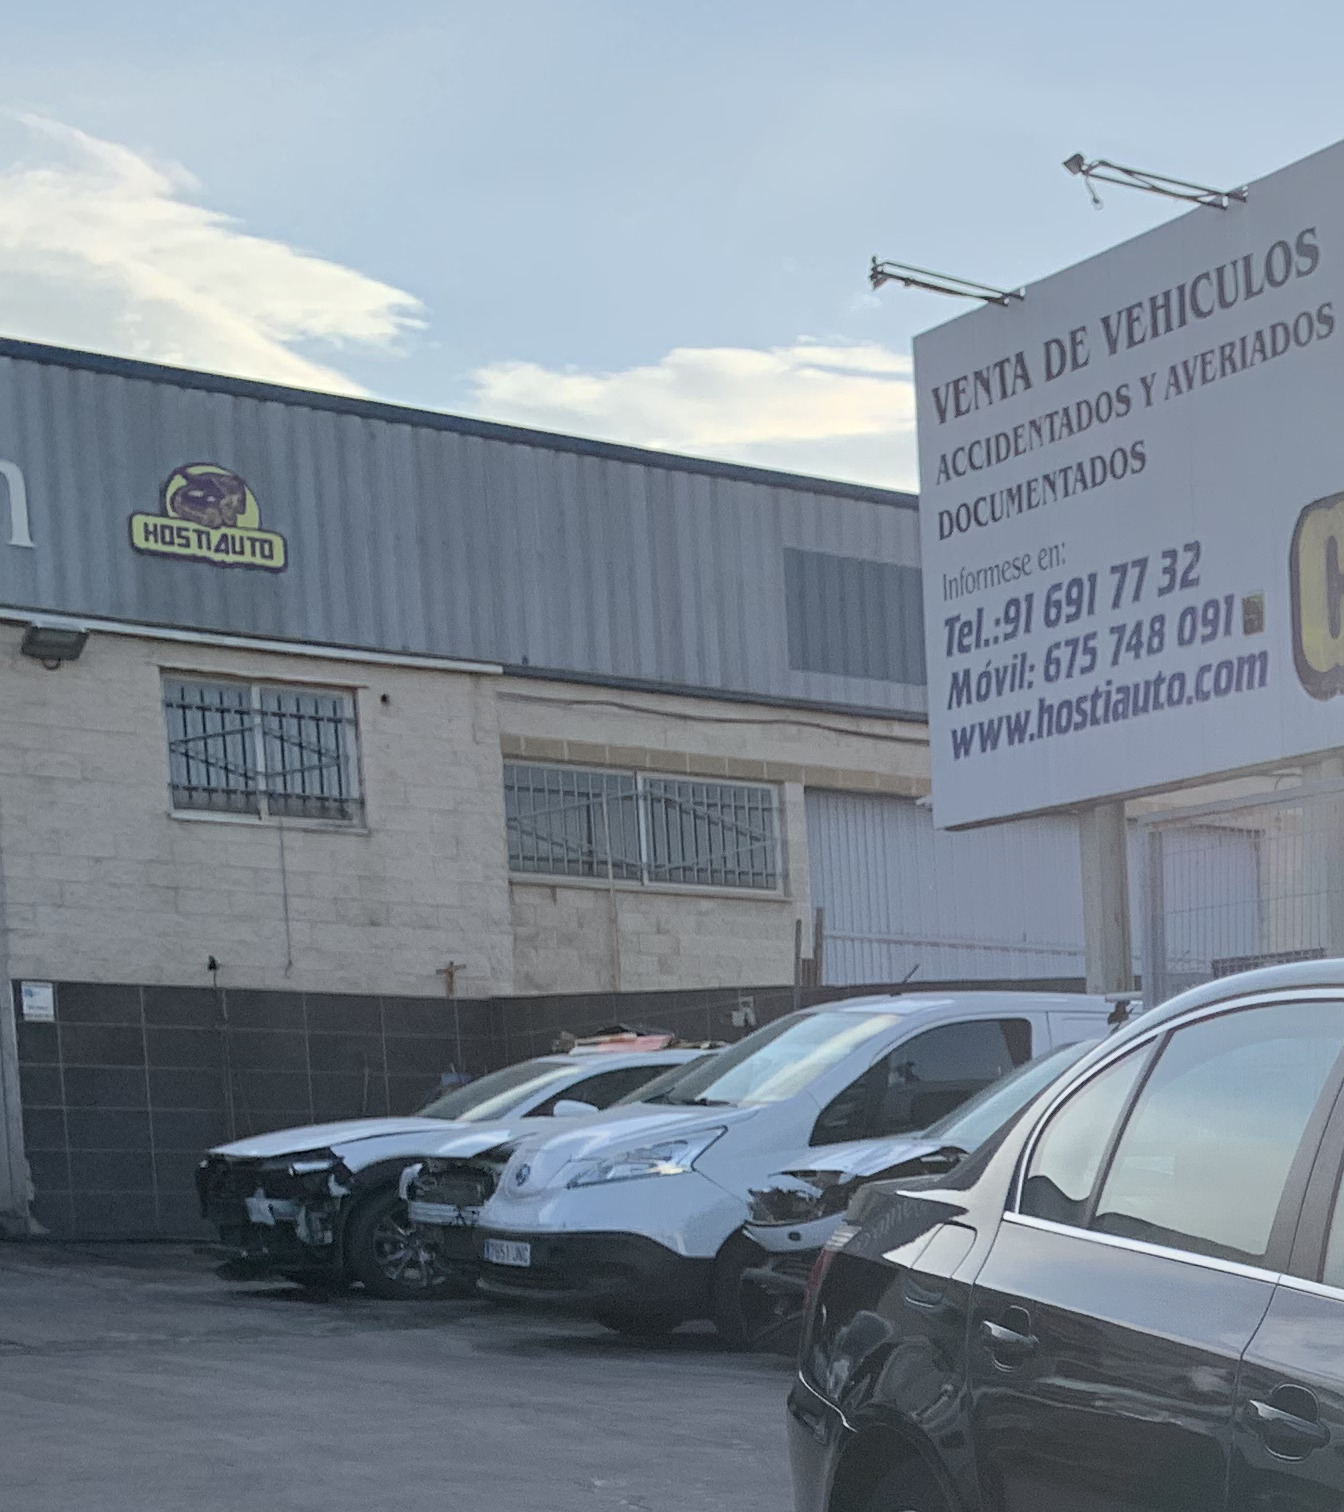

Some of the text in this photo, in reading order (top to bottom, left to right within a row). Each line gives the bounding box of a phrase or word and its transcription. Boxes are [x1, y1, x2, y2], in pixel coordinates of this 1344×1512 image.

[932, 227, 1321, 425] VENTA DE VEHICULOS
[936, 302, 1336, 485] ACCIDENTADOS Y AVERIADOS
[143, 522, 275, 560] HOSTIAUTO
[938, 441, 1148, 540] DOCUMENTADOS
[943, 541, 1067, 601] Informese en:
[1043, 573, 1099, 629] 691
[1109, 556, 1149, 610] 77
[1157, 540, 1202, 598] 32
[946, 594, 1235, 710] Móvil: 675 748 091
[950, 650, 1269, 761] www.hostiauto.com
